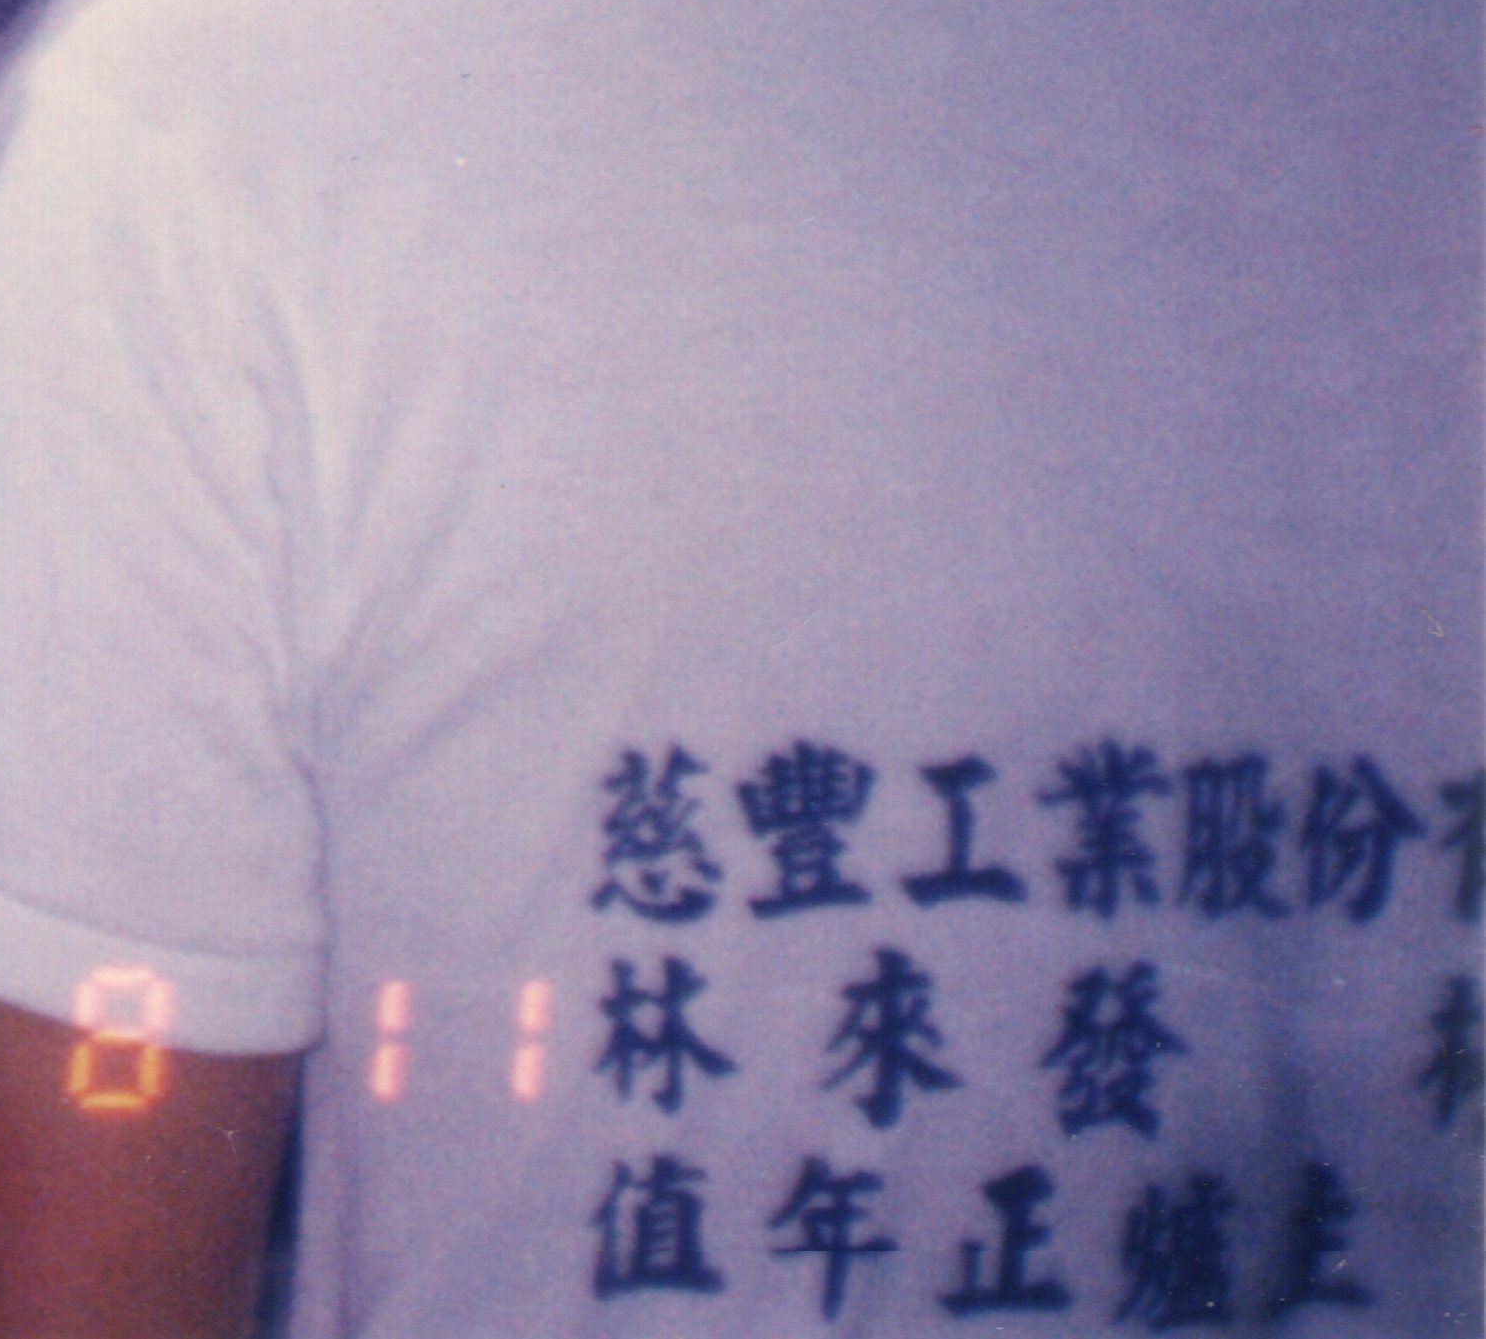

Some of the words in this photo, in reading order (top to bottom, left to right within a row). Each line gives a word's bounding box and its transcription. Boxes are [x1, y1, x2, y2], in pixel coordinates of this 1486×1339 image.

[595, 950, 1188, 1138] 林來發
[592, 1156, 1375, 1332] 值年正爐主
